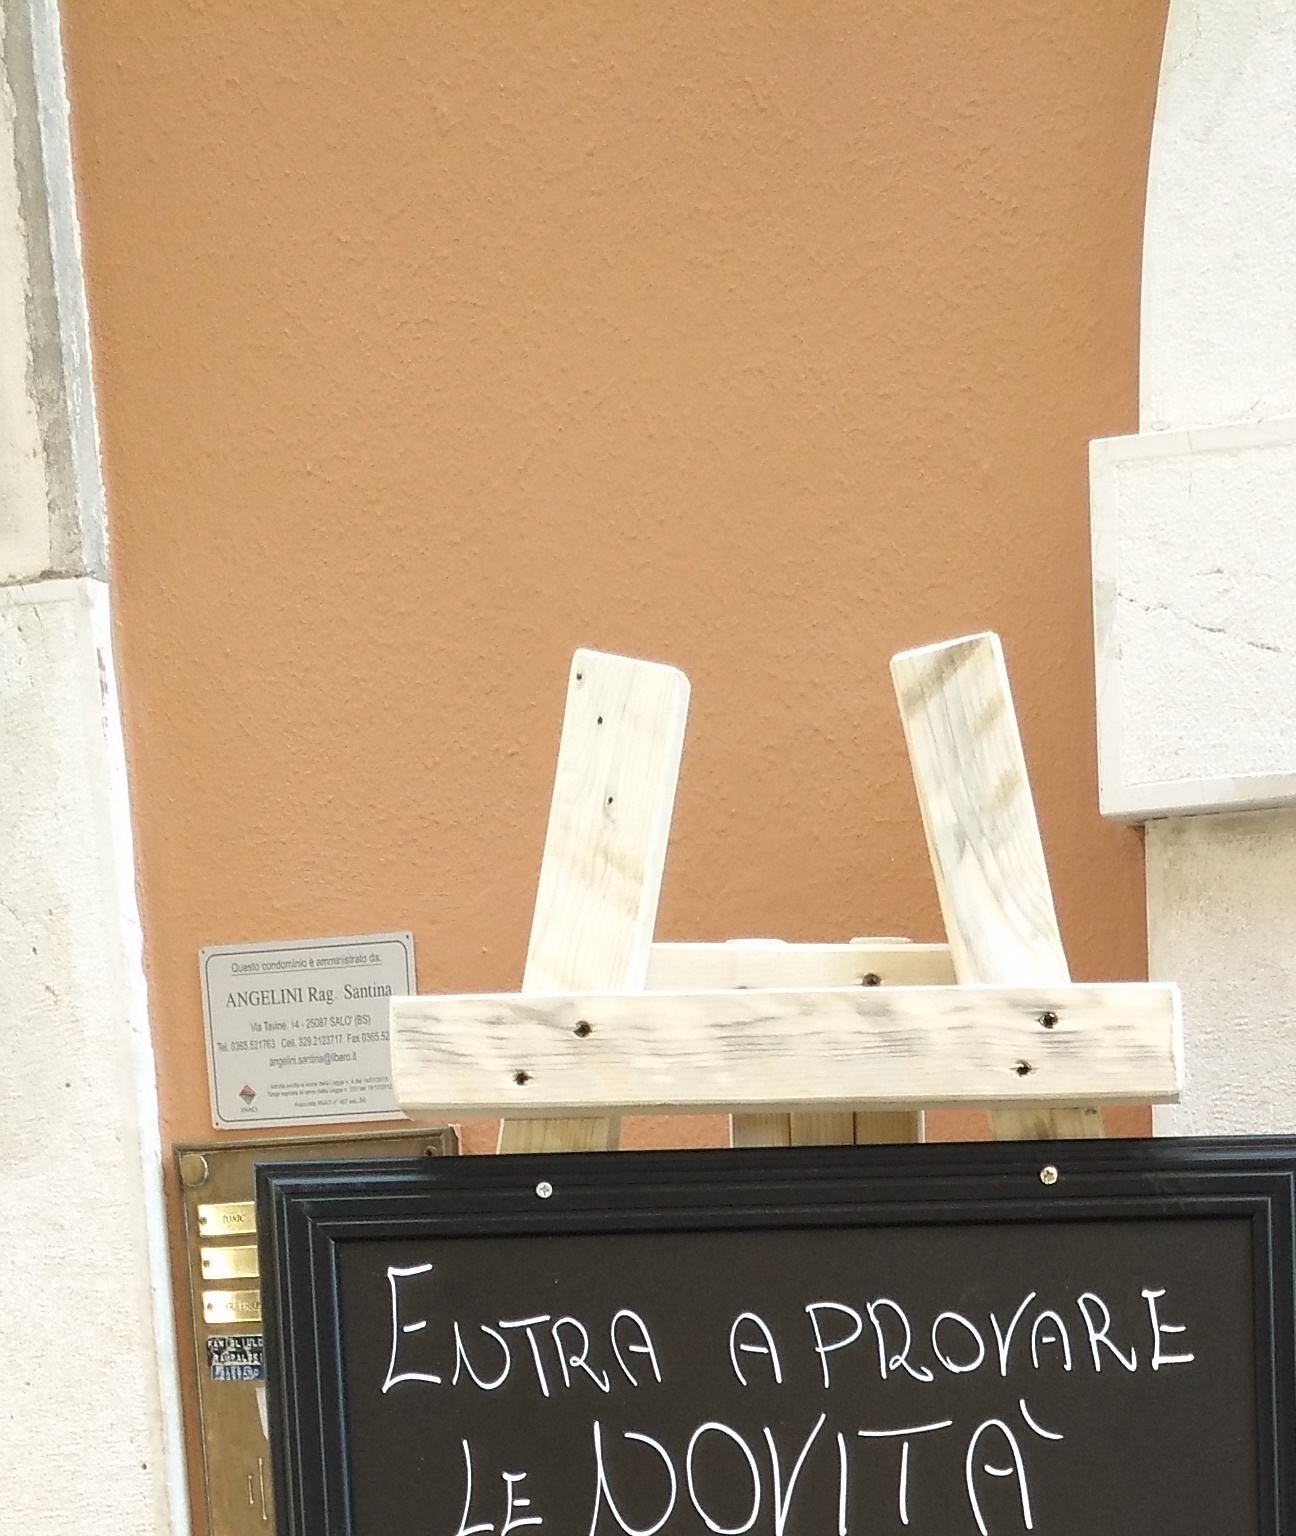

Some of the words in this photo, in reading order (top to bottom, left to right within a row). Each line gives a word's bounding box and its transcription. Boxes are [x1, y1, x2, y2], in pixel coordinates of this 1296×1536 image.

[231, 962, 260, 973] Questo
[261, 959, 307, 971] condominio
[316, 955, 367, 967] amministrato
[226, 987, 303, 1008] ANGELINI
[344, 981, 392, 1000] Santina
[250, 1021, 262, 1032] Via
[355, 1014, 371, 1027] (BS)
[347, 1032, 361, 1043] Fax
[361, 1031, 390, 1042] 0365.52
[382, 1264, 661, 1397] ENTRA
[730, 1312, 782, 1385] A
[805, 1289, 1194, 1388] PROVARE
